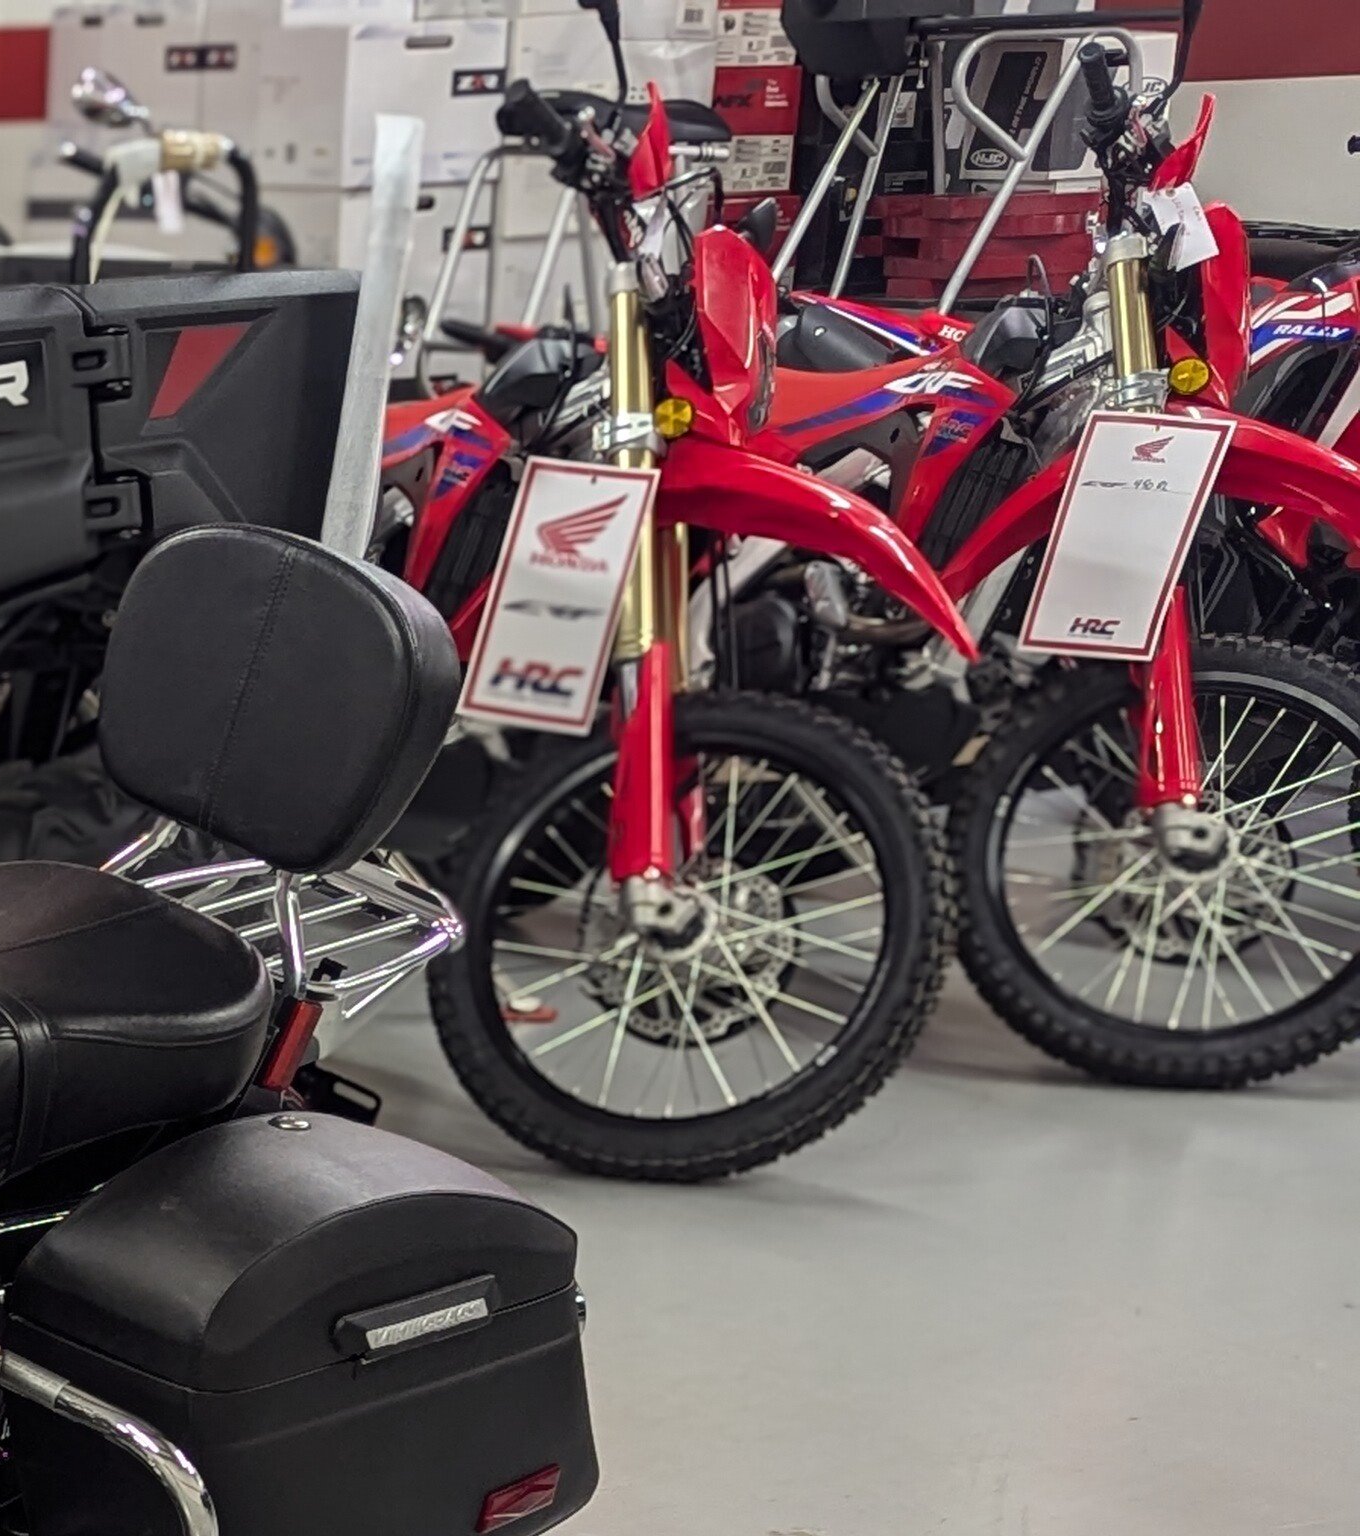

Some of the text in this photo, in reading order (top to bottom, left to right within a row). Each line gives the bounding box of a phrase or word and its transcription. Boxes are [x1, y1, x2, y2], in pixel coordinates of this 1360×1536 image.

[1273, 324, 1350, 339] RALLY
[1131, 455, 1167, 464] HONDA
[529, 551, 609, 573] HONDA
[1069, 617, 1121, 635] HRC
[488, 656, 586, 697] HRC
